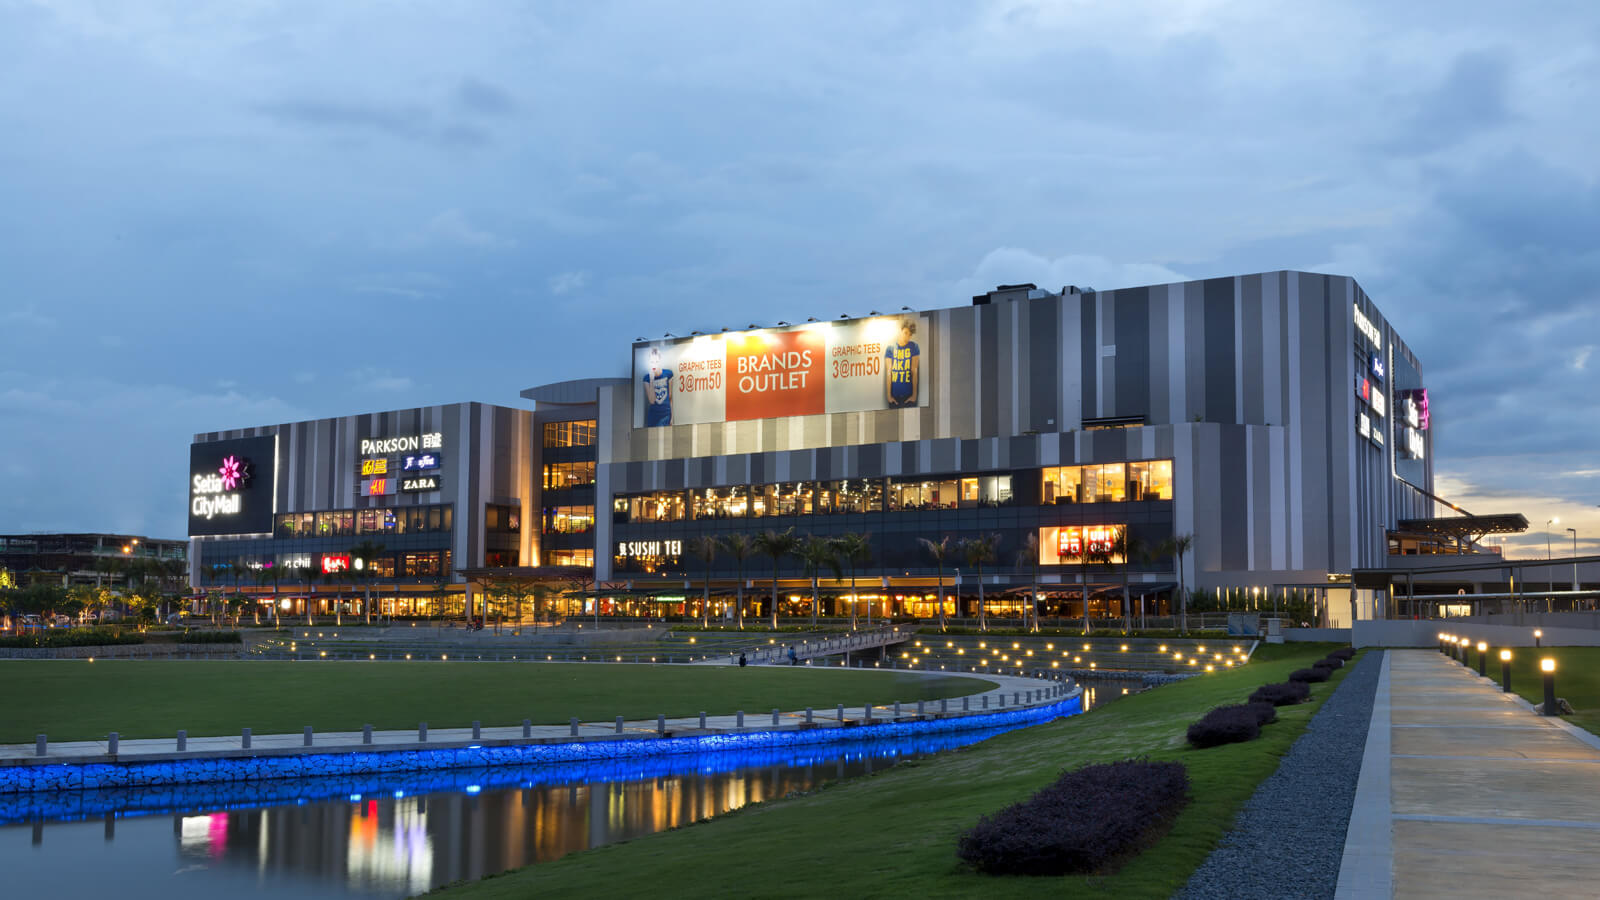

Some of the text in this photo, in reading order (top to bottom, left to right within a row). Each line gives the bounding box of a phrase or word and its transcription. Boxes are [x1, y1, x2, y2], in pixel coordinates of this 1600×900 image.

[832, 343, 881, 358] GRAPHIC TEES
[679, 359, 722, 373] GRAPHIC TEES
[737, 350, 812, 374] BRANDS
[832, 356, 880, 379] 3@rm50
[679, 371, 722, 393] 3@rm50
[738, 370, 809, 394] OUTLET
[361, 436, 419, 455] PARKSON
[193, 474, 223, 494] Setia
[403, 478, 436, 490] ZARA
[628, 541, 660, 556] SUSHI
[664, 540, 682, 556] TEI
[284, 557, 312, 569] nchii
